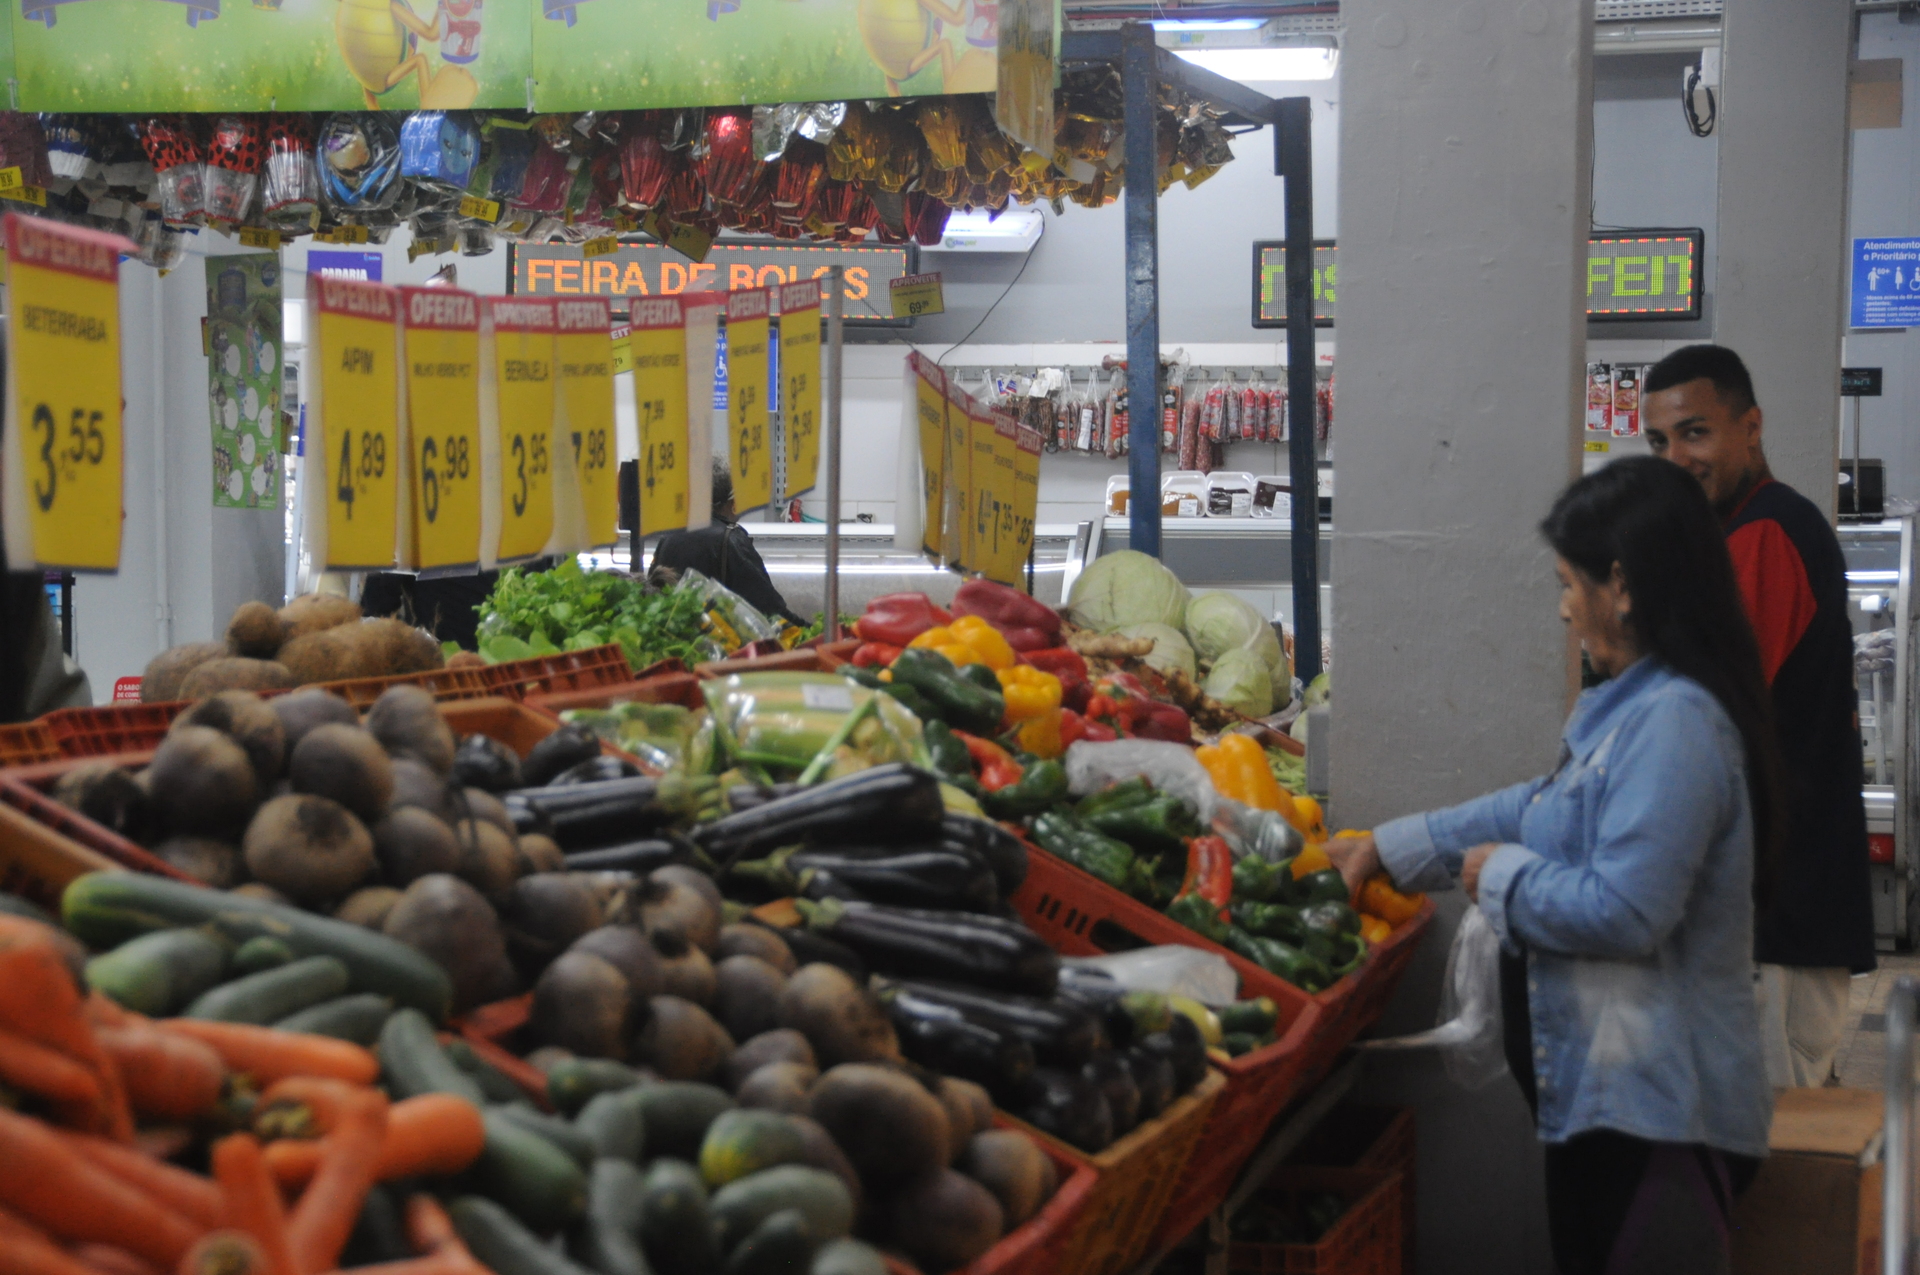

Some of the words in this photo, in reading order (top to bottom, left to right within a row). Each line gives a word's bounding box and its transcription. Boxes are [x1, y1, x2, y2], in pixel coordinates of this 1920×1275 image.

[1863, 241, 1920, 250] Atendimento
[1871, 252, 1917, 260] Prioritário
[528, 259, 648, 295] FEIRA
[659, 262, 715, 295] DE
[892, 273, 938, 288] APROVEITE
[325, 284, 391, 317] OFERTA
[410, 293, 475, 326] OFERTA
[728, 292, 767, 319] OFERTA
[782, 282, 819, 310] OFERTA
[23, 304, 108, 343] BETERRABA
[557, 300, 609, 329] OFERTA
[632, 299, 682, 325] OFERTA
[341, 346, 375, 377] AIPIM
[1016, 427, 1041, 453] OFERTA
